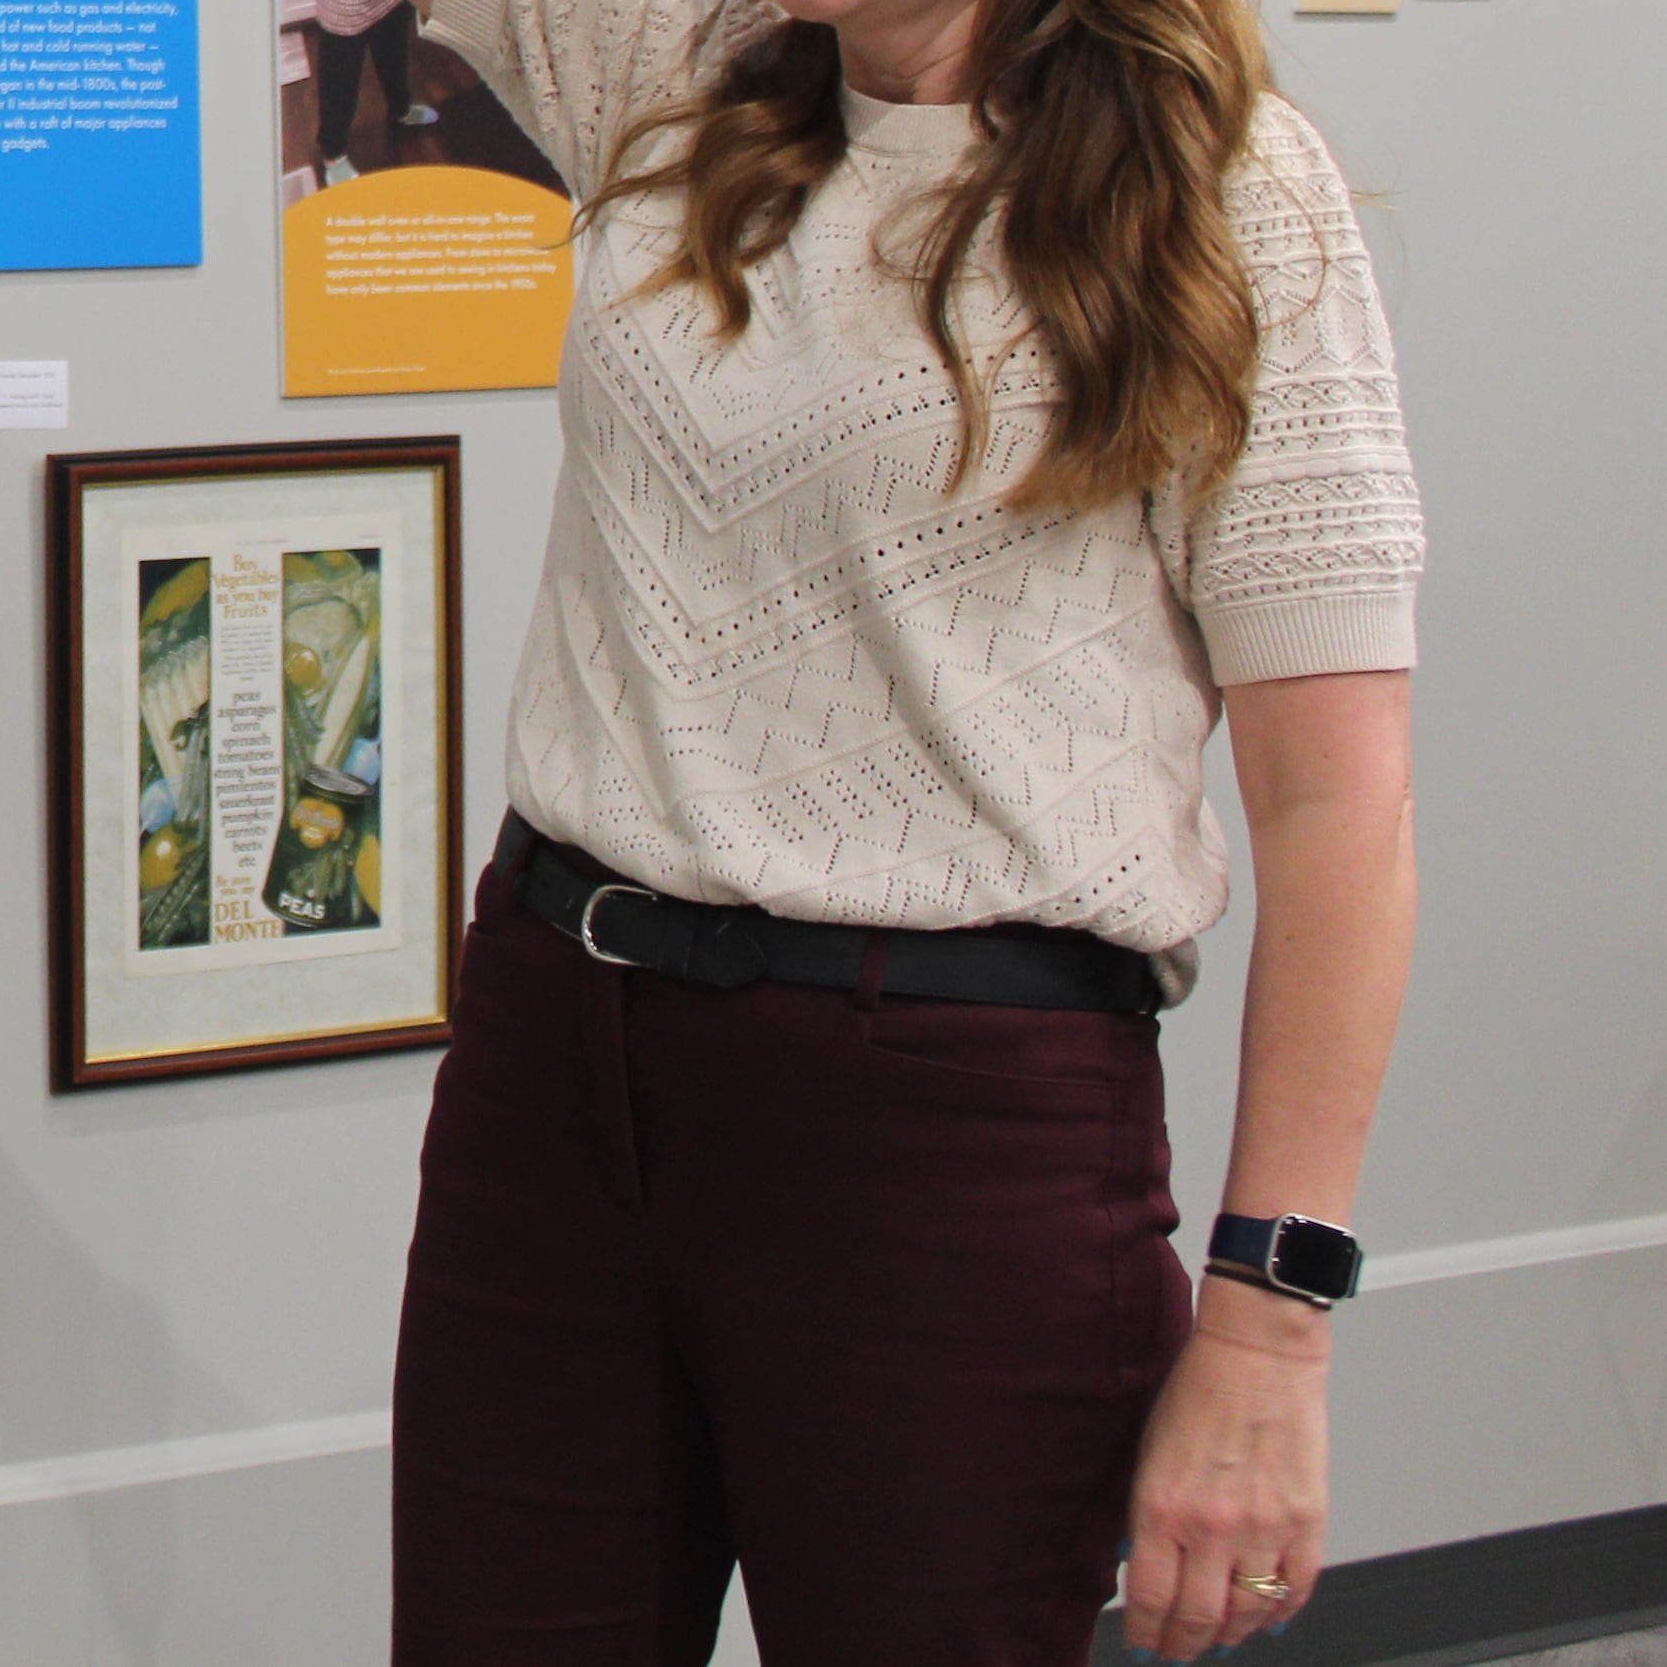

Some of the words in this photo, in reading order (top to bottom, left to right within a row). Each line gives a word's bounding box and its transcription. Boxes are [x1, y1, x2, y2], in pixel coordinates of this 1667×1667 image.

[223, 605, 267, 619] Fruits
[215, 901, 255, 922] DEL
[278, 892, 325, 920] PEAS
[215, 922, 280, 943] MONTE
